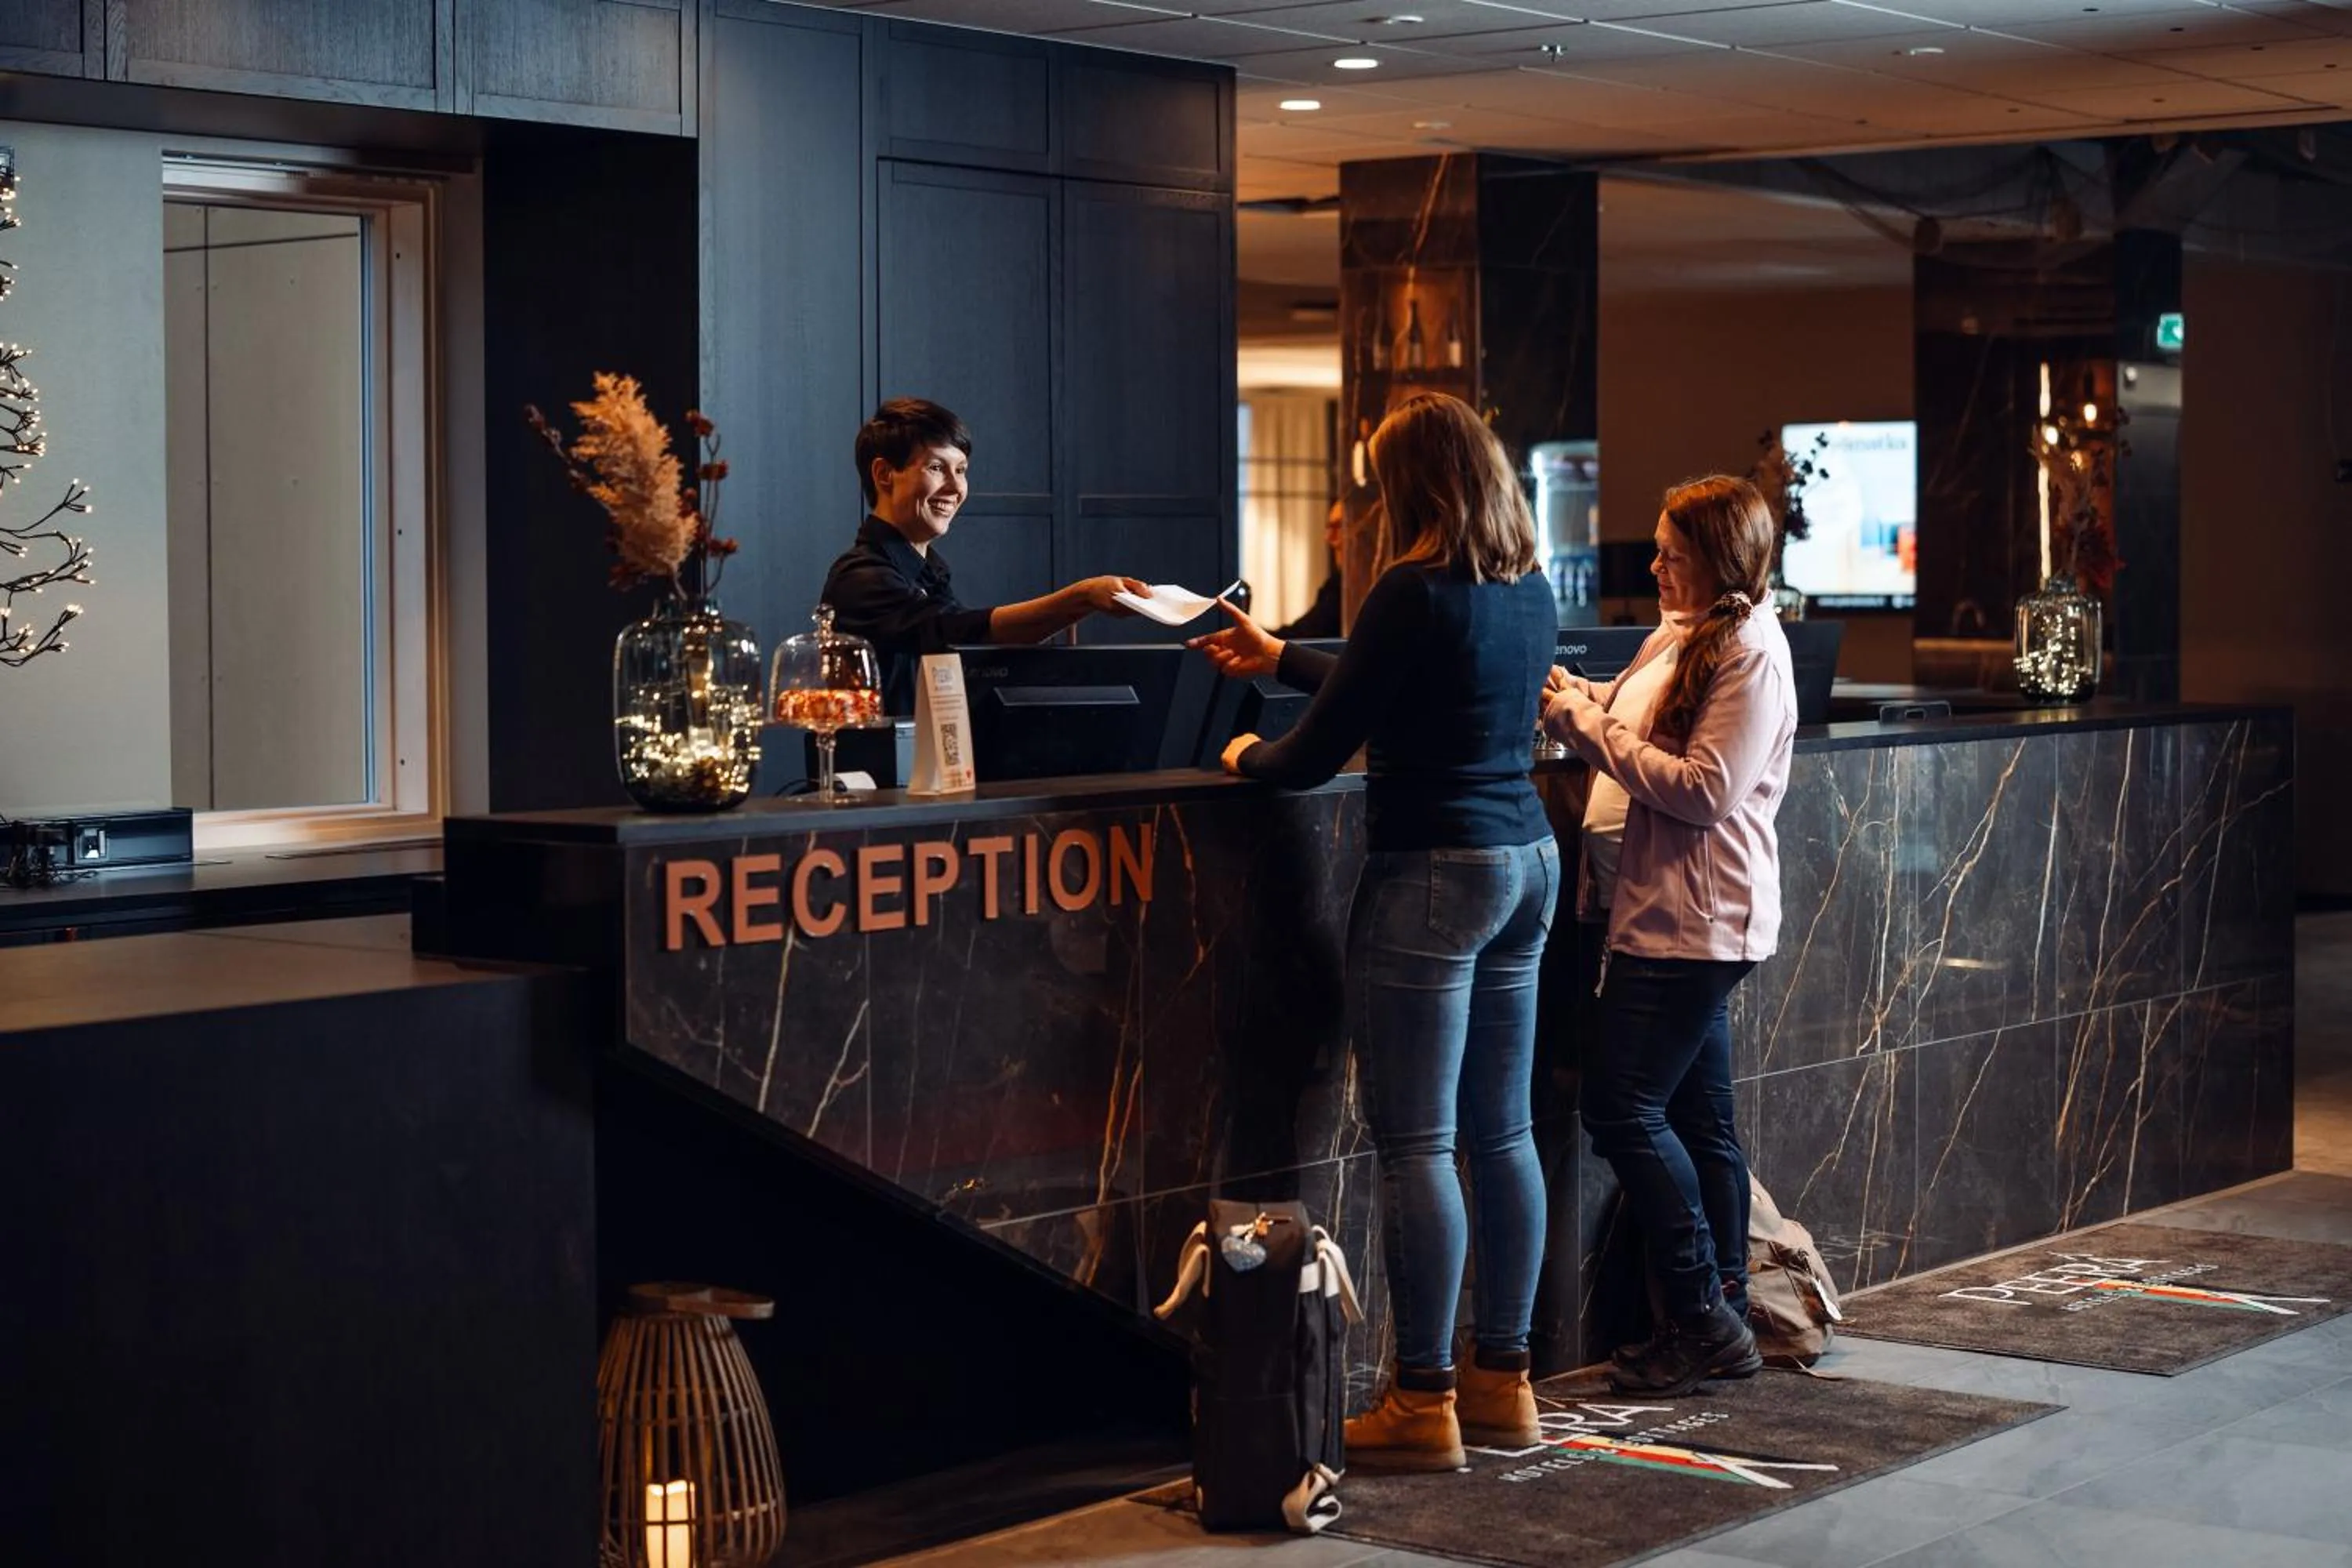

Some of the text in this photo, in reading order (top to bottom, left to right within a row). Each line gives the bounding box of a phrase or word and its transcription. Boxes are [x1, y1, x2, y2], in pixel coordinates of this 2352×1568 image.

[1554, 644, 1588, 655] enovo
[666, 823, 1155, 951] RECEPTION
[1498, 1453, 1596, 1483] HOTELS
